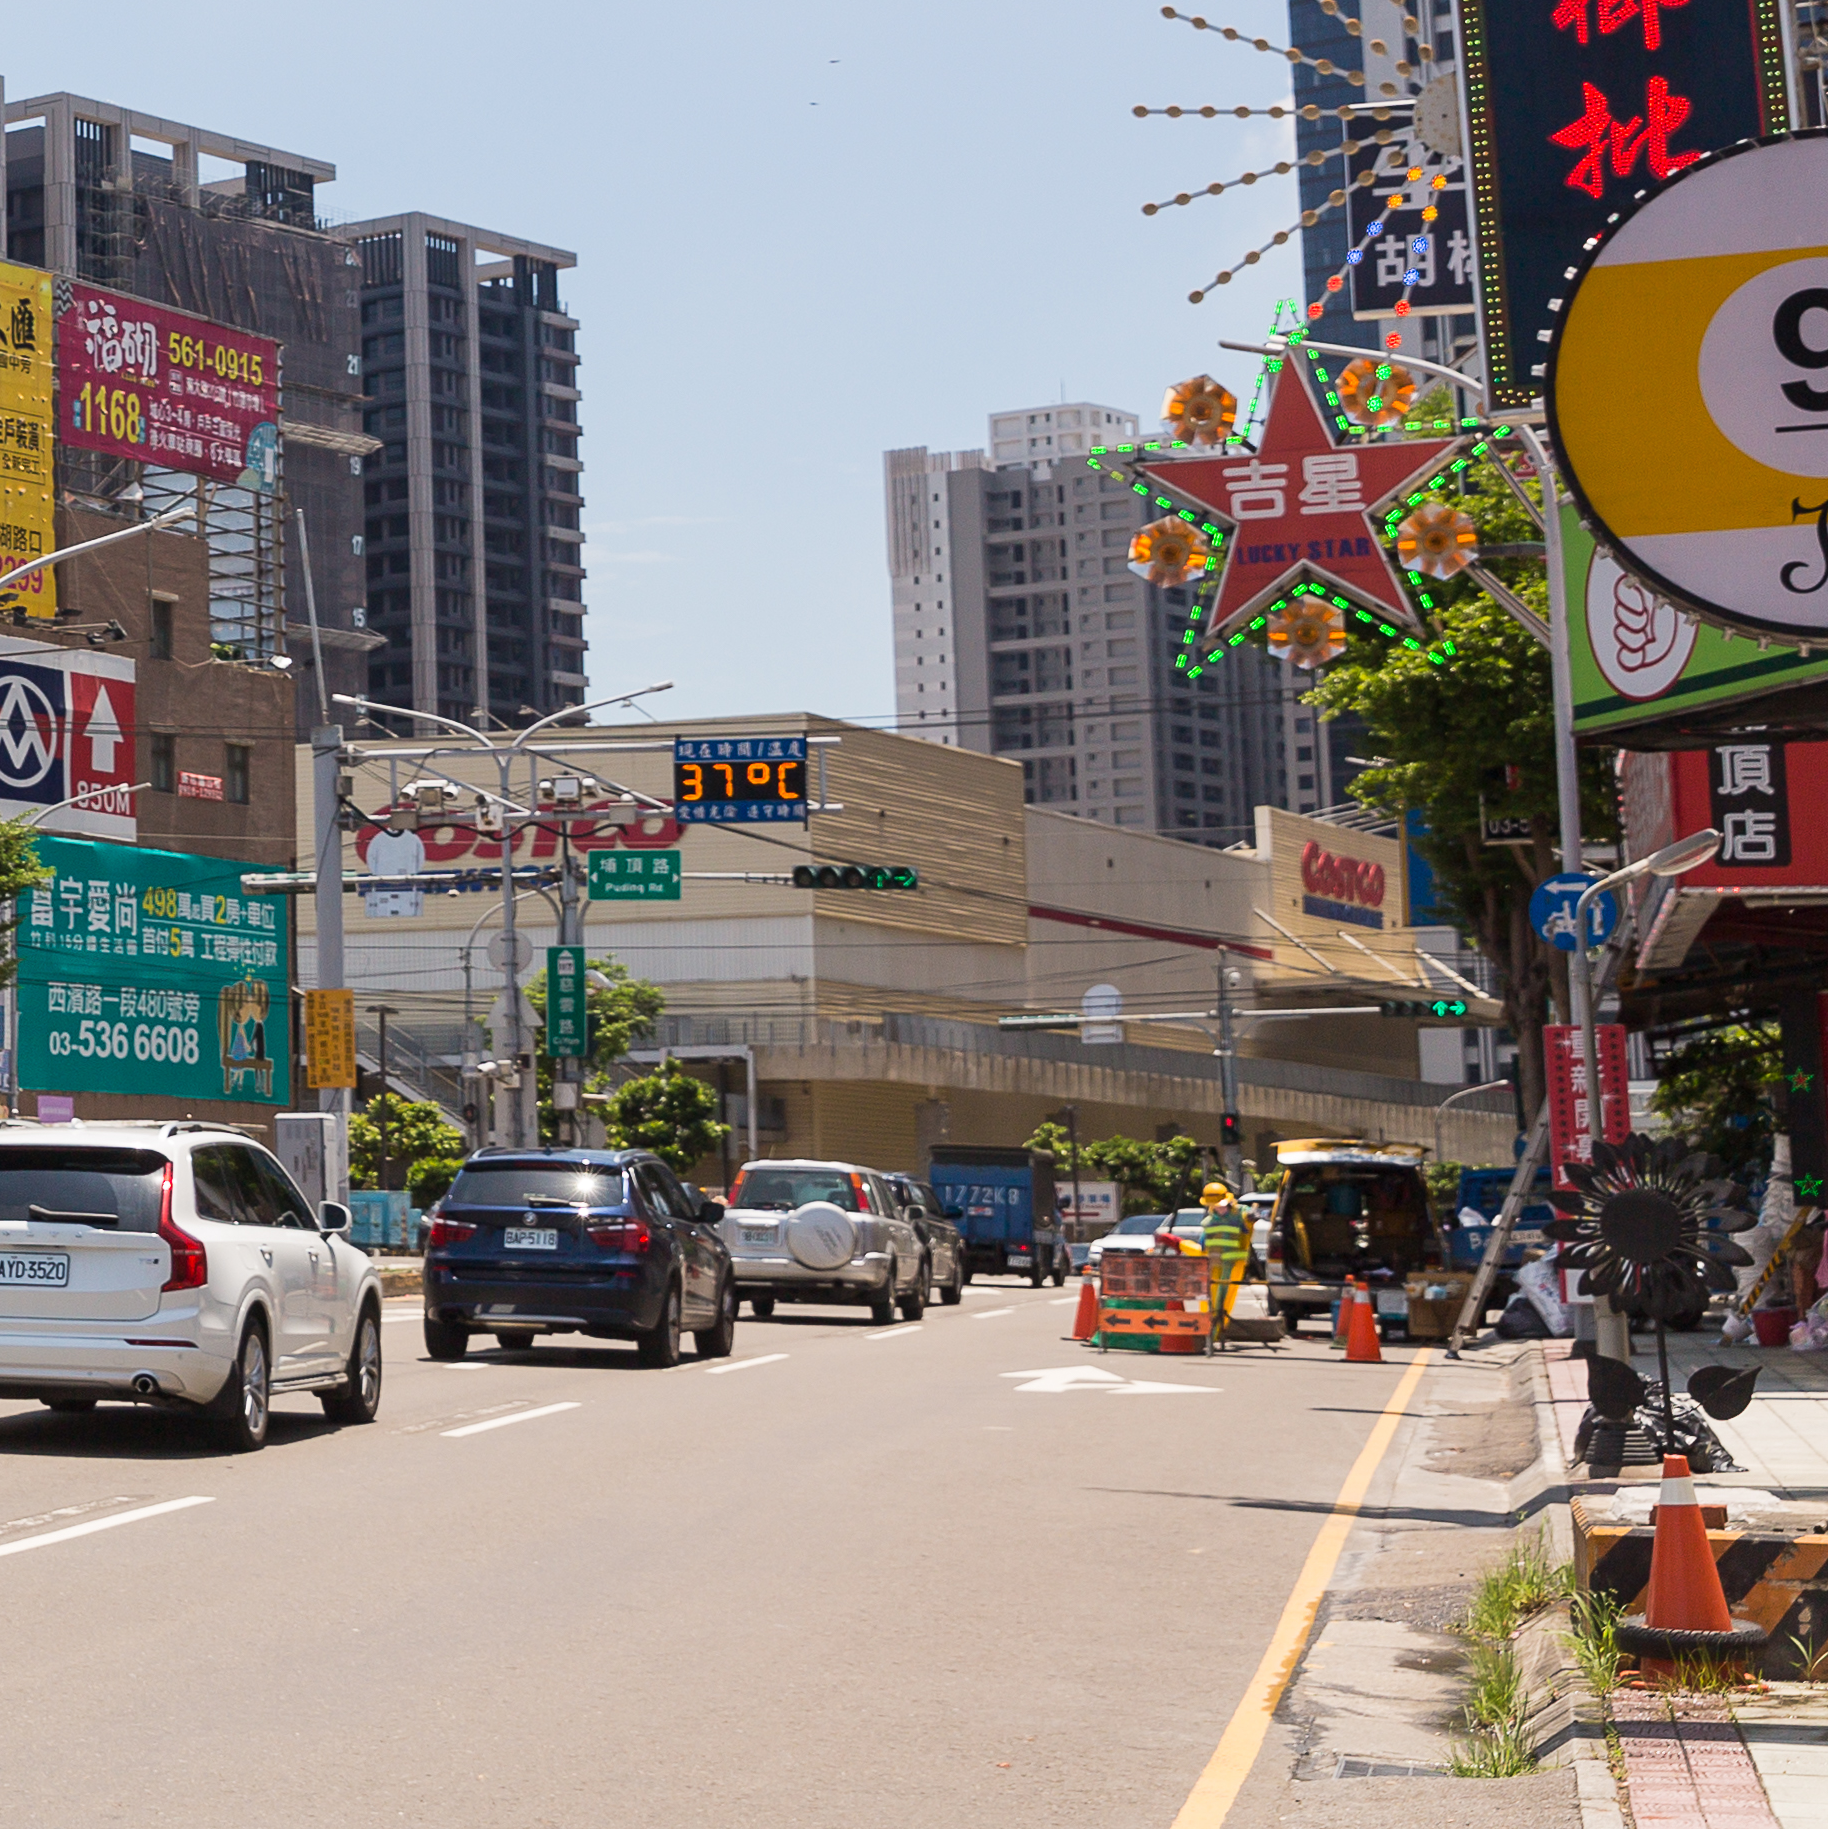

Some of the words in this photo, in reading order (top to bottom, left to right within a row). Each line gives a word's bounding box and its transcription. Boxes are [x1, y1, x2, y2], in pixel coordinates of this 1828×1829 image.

[168, 332, 262, 386] 561-0915
[80, 381, 141, 443] 1168
[1222, 453, 1366, 520] 吉星
[1237, 543, 1300, 564] LUCKY
[1308, 538, 1370, 560] STAR
[605, 883, 644, 894] Puding
[648, 883, 663, 892] Rd
[49, 1020, 128, 1059] 03-536
[134, 1023, 199, 1064] 6608
